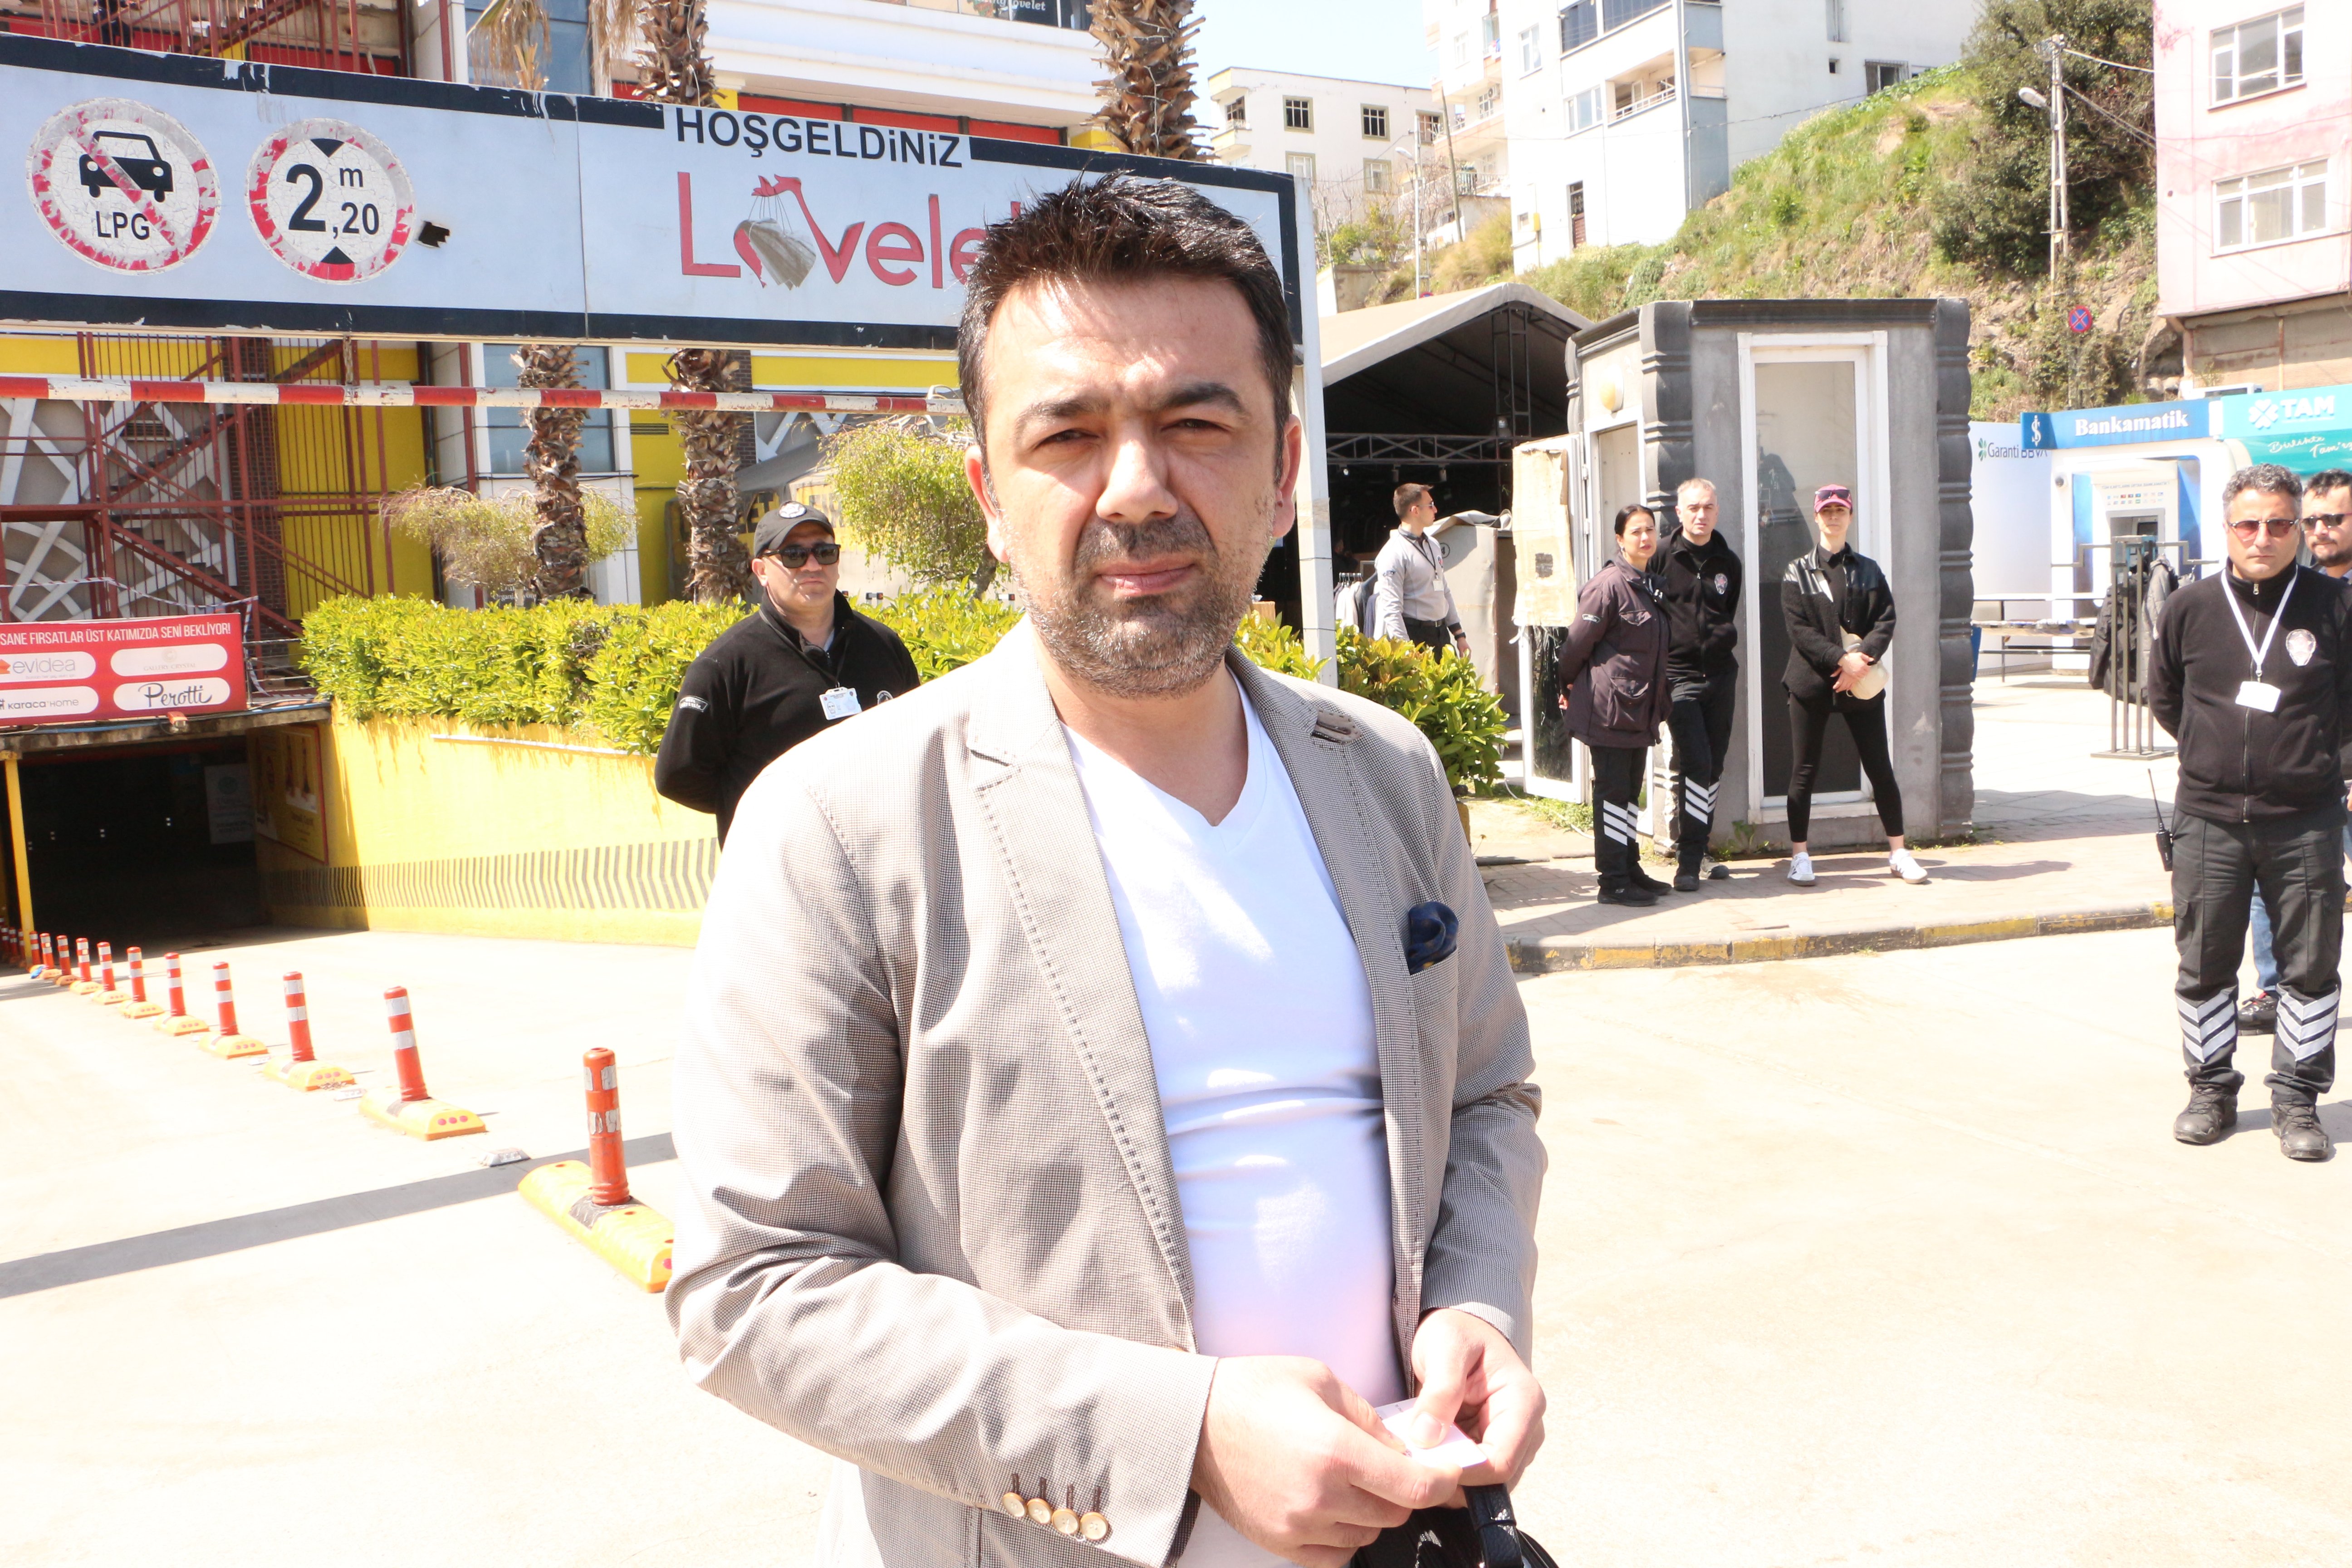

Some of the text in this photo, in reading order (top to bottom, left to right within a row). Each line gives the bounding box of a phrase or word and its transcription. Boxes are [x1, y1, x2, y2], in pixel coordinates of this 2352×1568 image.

[1011, 0, 1046, 11] ovelet
[95, 210, 151, 240] LPG
[677, 171, 1021, 291] Lovele
[2280, 395, 2335, 419] TAM
[2075, 410, 2189, 436] Bankamatik
[1987, 442, 2019, 459] Garanti
[0, 622, 230, 646] SANE FIRSATLAR ÜST KATIMIZDA SENİ BEKLİYOR!
[13, 657, 76, 674] evidea
[137, 682, 212, 708] Perotti
